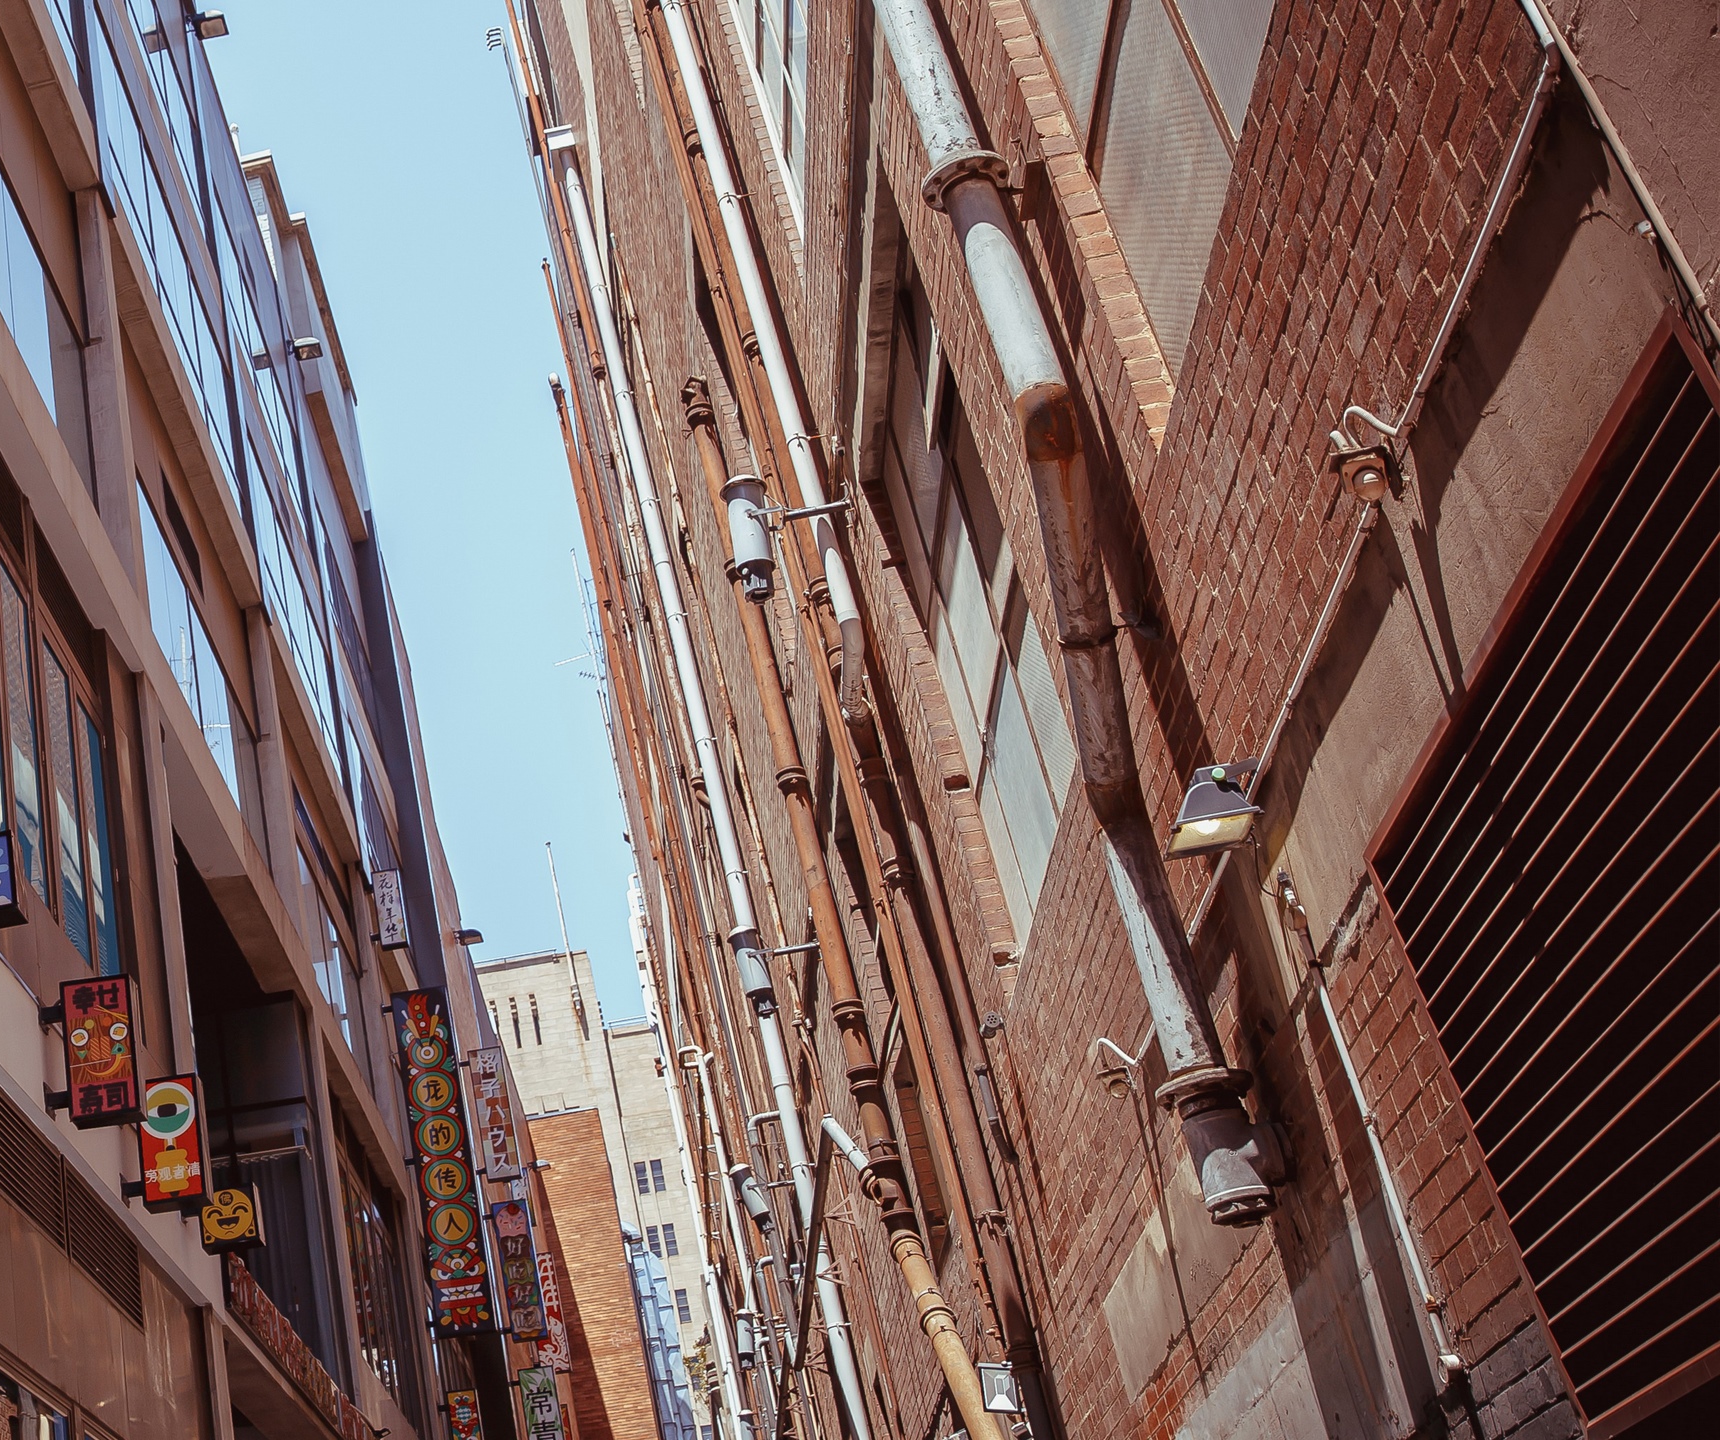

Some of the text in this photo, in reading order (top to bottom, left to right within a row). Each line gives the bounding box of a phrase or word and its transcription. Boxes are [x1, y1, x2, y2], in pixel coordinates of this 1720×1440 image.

[378, 873, 399, 942] 花样年华
[72, 982, 120, 1015] 幸せ
[78, 1081, 130, 1115] 寿司
[476, 1053, 512, 1174] 格子ハウス
[505, 1236, 540, 1328] 好吃好吃
